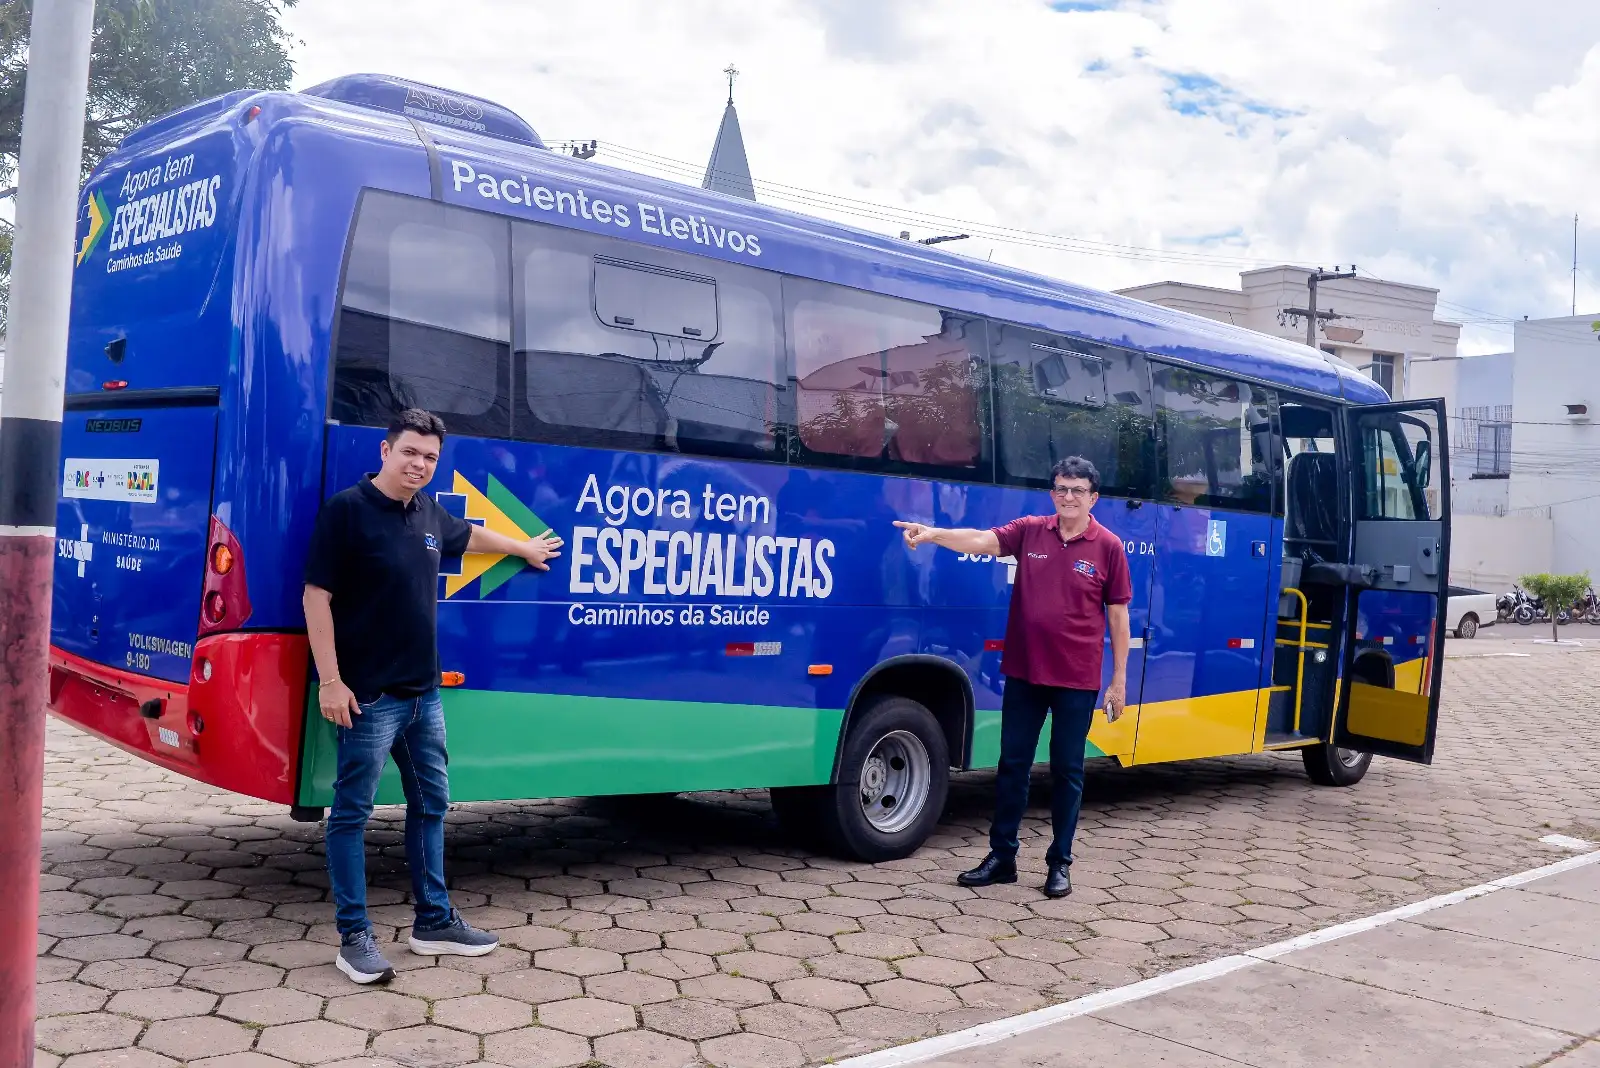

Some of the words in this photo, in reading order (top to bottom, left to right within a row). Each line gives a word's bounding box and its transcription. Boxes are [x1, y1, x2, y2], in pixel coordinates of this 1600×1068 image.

[120, 165, 160, 201] Agora
[163, 153, 195, 180] tem
[109, 175, 221, 252] ESPECIALISTAS
[451, 160, 631, 228] Pacientes
[637, 202, 762, 256] Eletivos
[106, 253, 143, 273] Caminhos
[143, 249, 154, 265] da
[155, 241, 182, 263] Saúde
[87, 419, 140, 432] NEOBUS
[575, 473, 691, 526] Agora
[702, 483, 770, 524] tem
[58, 538, 74, 559] SUS
[102, 531, 147, 550] MINISTÉRIO
[149, 537, 160, 552] DA
[1140, 541, 1155, 556] DA
[116, 553, 142, 572] SAÚDE
[569, 526, 836, 599] ESPECIALISTAS
[568, 603, 674, 626] Caminhos
[679, 604, 705, 626] da
[709, 604, 770, 626] Saúde
[128, 632, 192, 659] VOLKSWAGEN
[126, 651, 150, 671] 9-180
